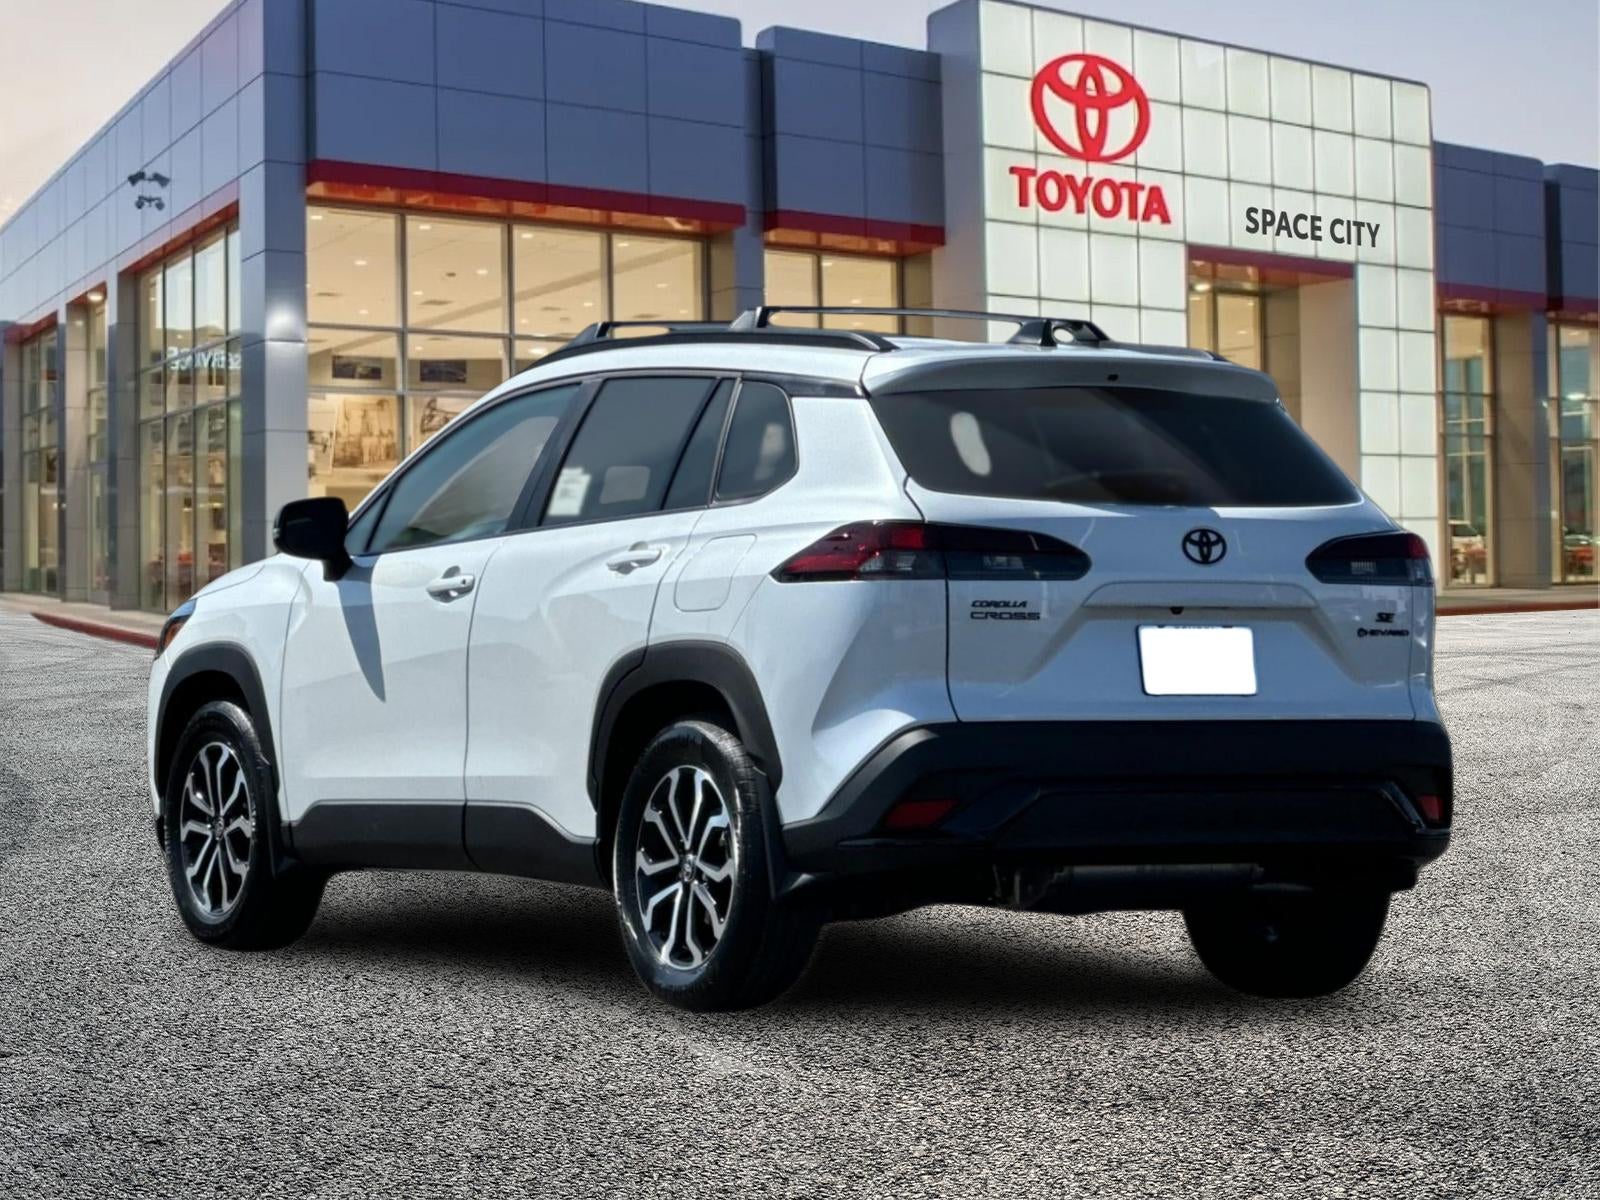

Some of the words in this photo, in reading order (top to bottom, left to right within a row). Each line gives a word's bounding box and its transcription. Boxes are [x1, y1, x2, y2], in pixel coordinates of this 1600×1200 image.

[1009, 166, 1171, 224] TOYOTA
[1245, 206, 1323, 242] SPACE
[1329, 218, 1380, 248] CITY
[970, 611, 1041, 620] CROSS
[971, 600, 1028, 608] COROLLA
